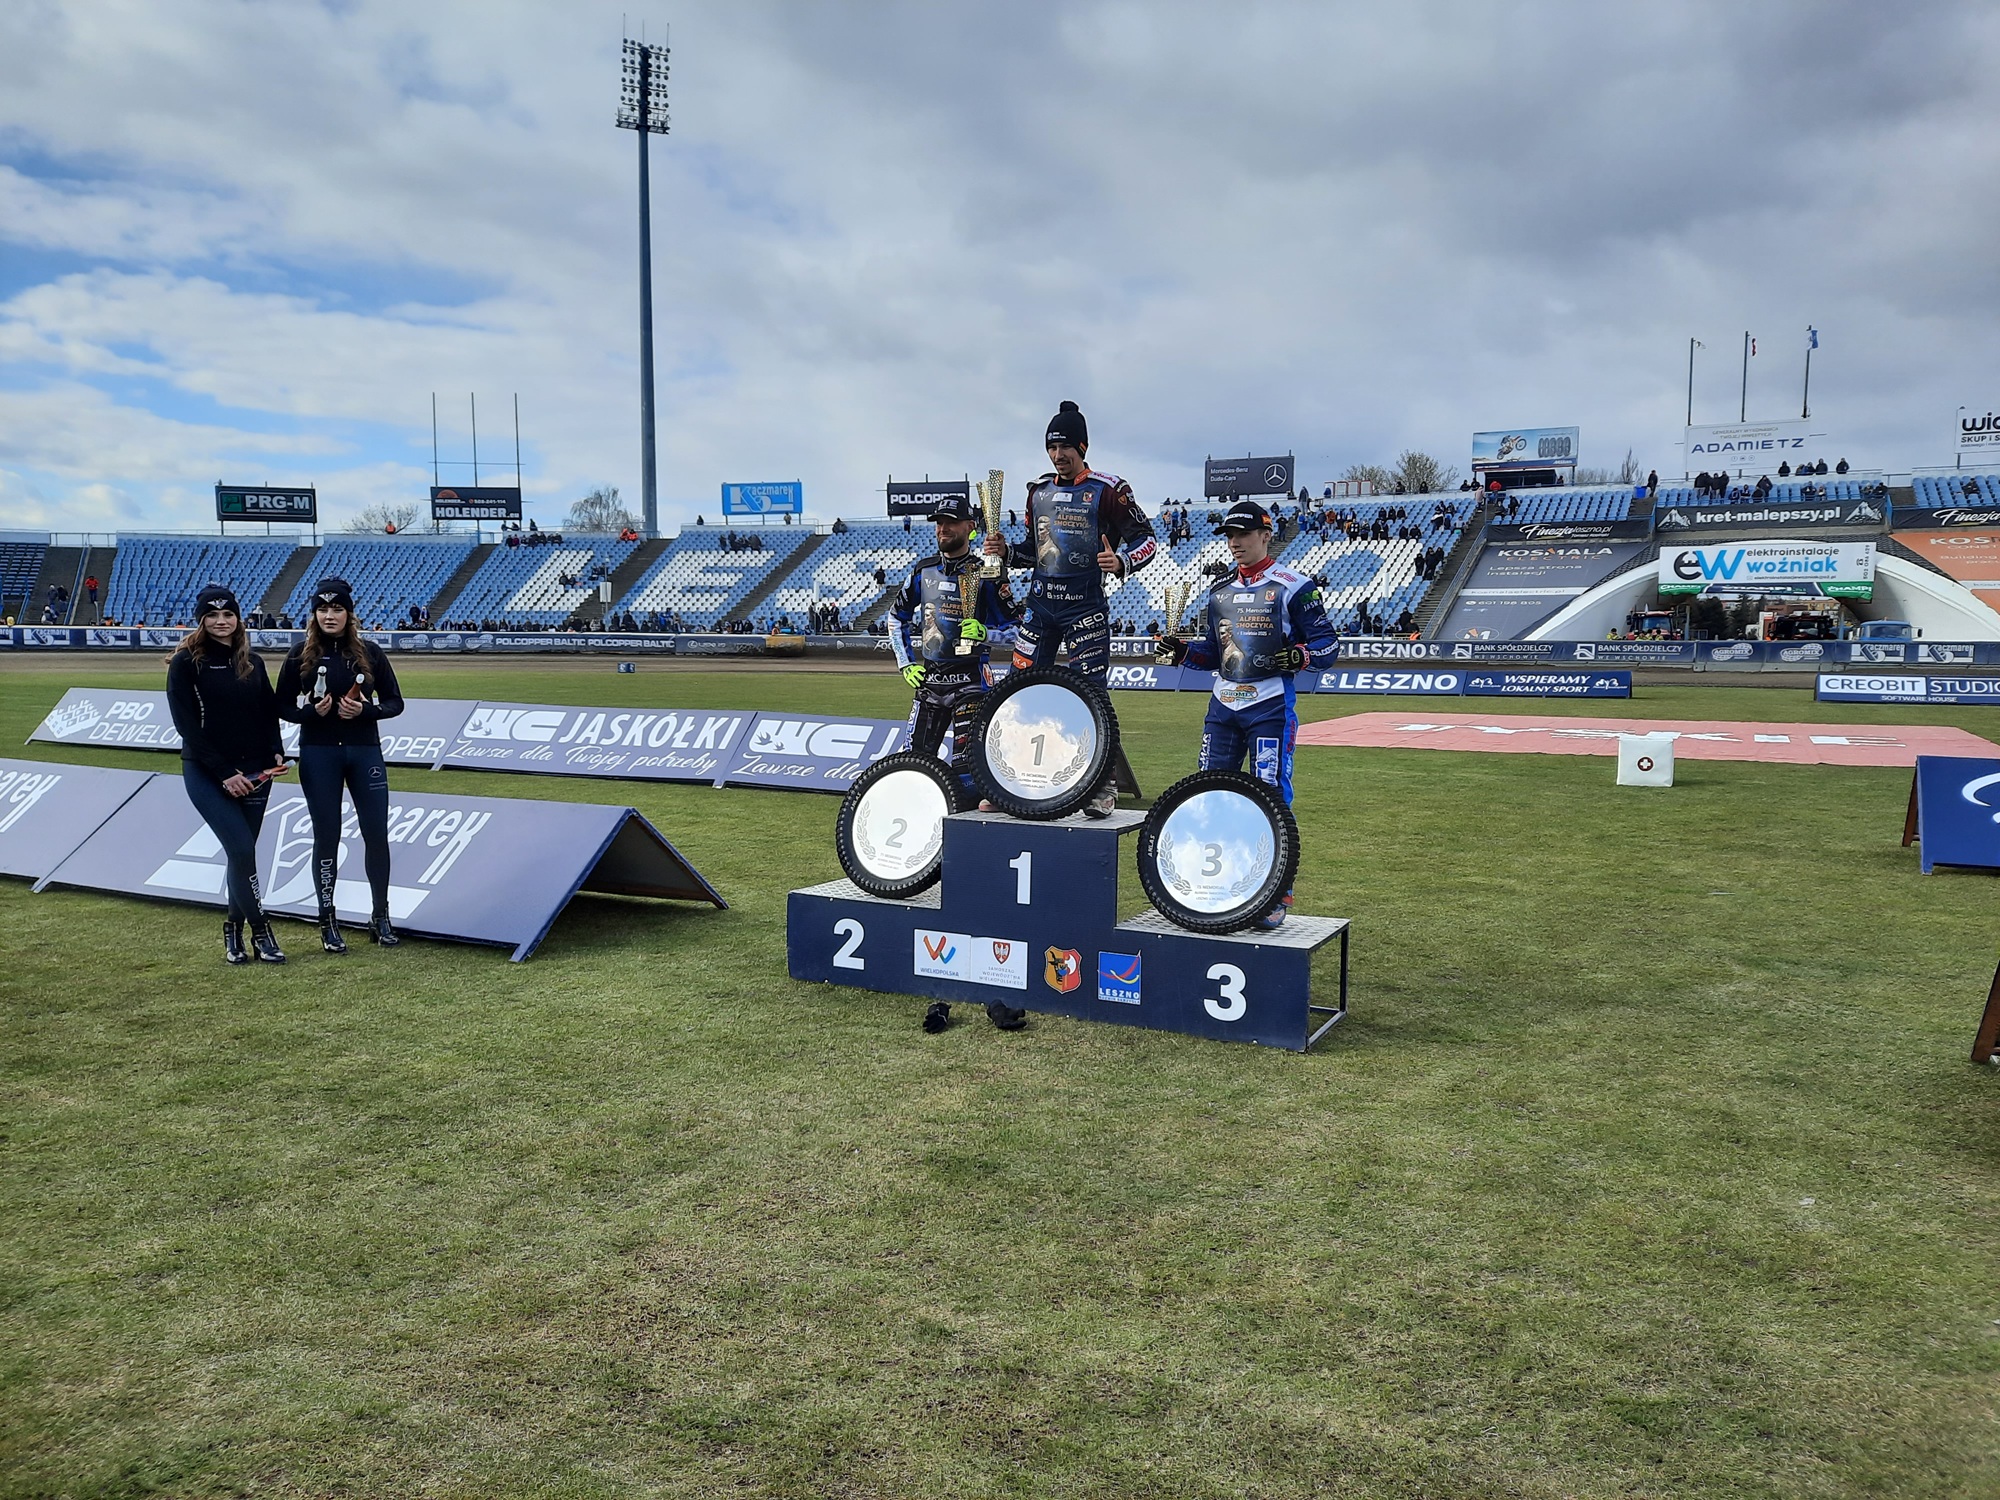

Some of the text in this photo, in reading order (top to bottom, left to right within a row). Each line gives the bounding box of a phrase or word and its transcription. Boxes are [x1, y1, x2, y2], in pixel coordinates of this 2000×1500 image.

[1691, 438, 1804, 454] ADAMIETZ
[245, 495, 309, 509] PRG-M
[1063, 506, 1089, 514] Memorial
[435, 507, 519, 518] HOLENDER.eu
[1057, 514, 1087, 522] ALFREDA
[1696, 507, 1840, 523] kret-malepszy.pl
[1130, 541, 1157, 563] SONAX
[1498, 547, 1613, 557] KOSMALA
[1746, 547, 1840, 557] elektroinstalacje
[1746, 556, 1838, 573] woźniak
[1047, 583, 1067, 591] BMW
[1047, 592, 1063, 600] Best
[1072, 613, 1104, 631] NEO
[496, 638, 552, 646] POLCOPPER
[588, 639, 675, 648] POLCOPPER BALTIC
[1497, 643, 1553, 651] SPÓŁDZIELCZY
[1622, 644, 1683, 652] SPÓŁDZIELCZY
[1348, 643, 1426, 659] LESZNO
[1339, 673, 1458, 690] LESZNO
[1505, 675, 1591, 685] WSPIERAMY
[1826, 679, 1920, 692] CREOBIT
[1501, 685, 1551, 693] LOKALNY
[105, 701, 154, 720] PBO
[463, 708, 742, 750] WC JASKÓŁKI
[447, 740, 718, 775] Zawsze dla Twojej potrzeby
[1031, 734, 1046, 766] 1
[732, 753, 815, 777] Zawsze
[885, 818, 907, 848] 2
[1201, 843, 1222, 876] 3
[320, 859, 333, 908] Duda-Cars
[1009, 851, 1031, 905] 1
[833, 918, 865, 970] 2
[920, 967, 959, 977] WIELKOPOLSKA
[1099, 988, 1139, 999] LESZNO
[1203, 963, 1246, 1022] 3
